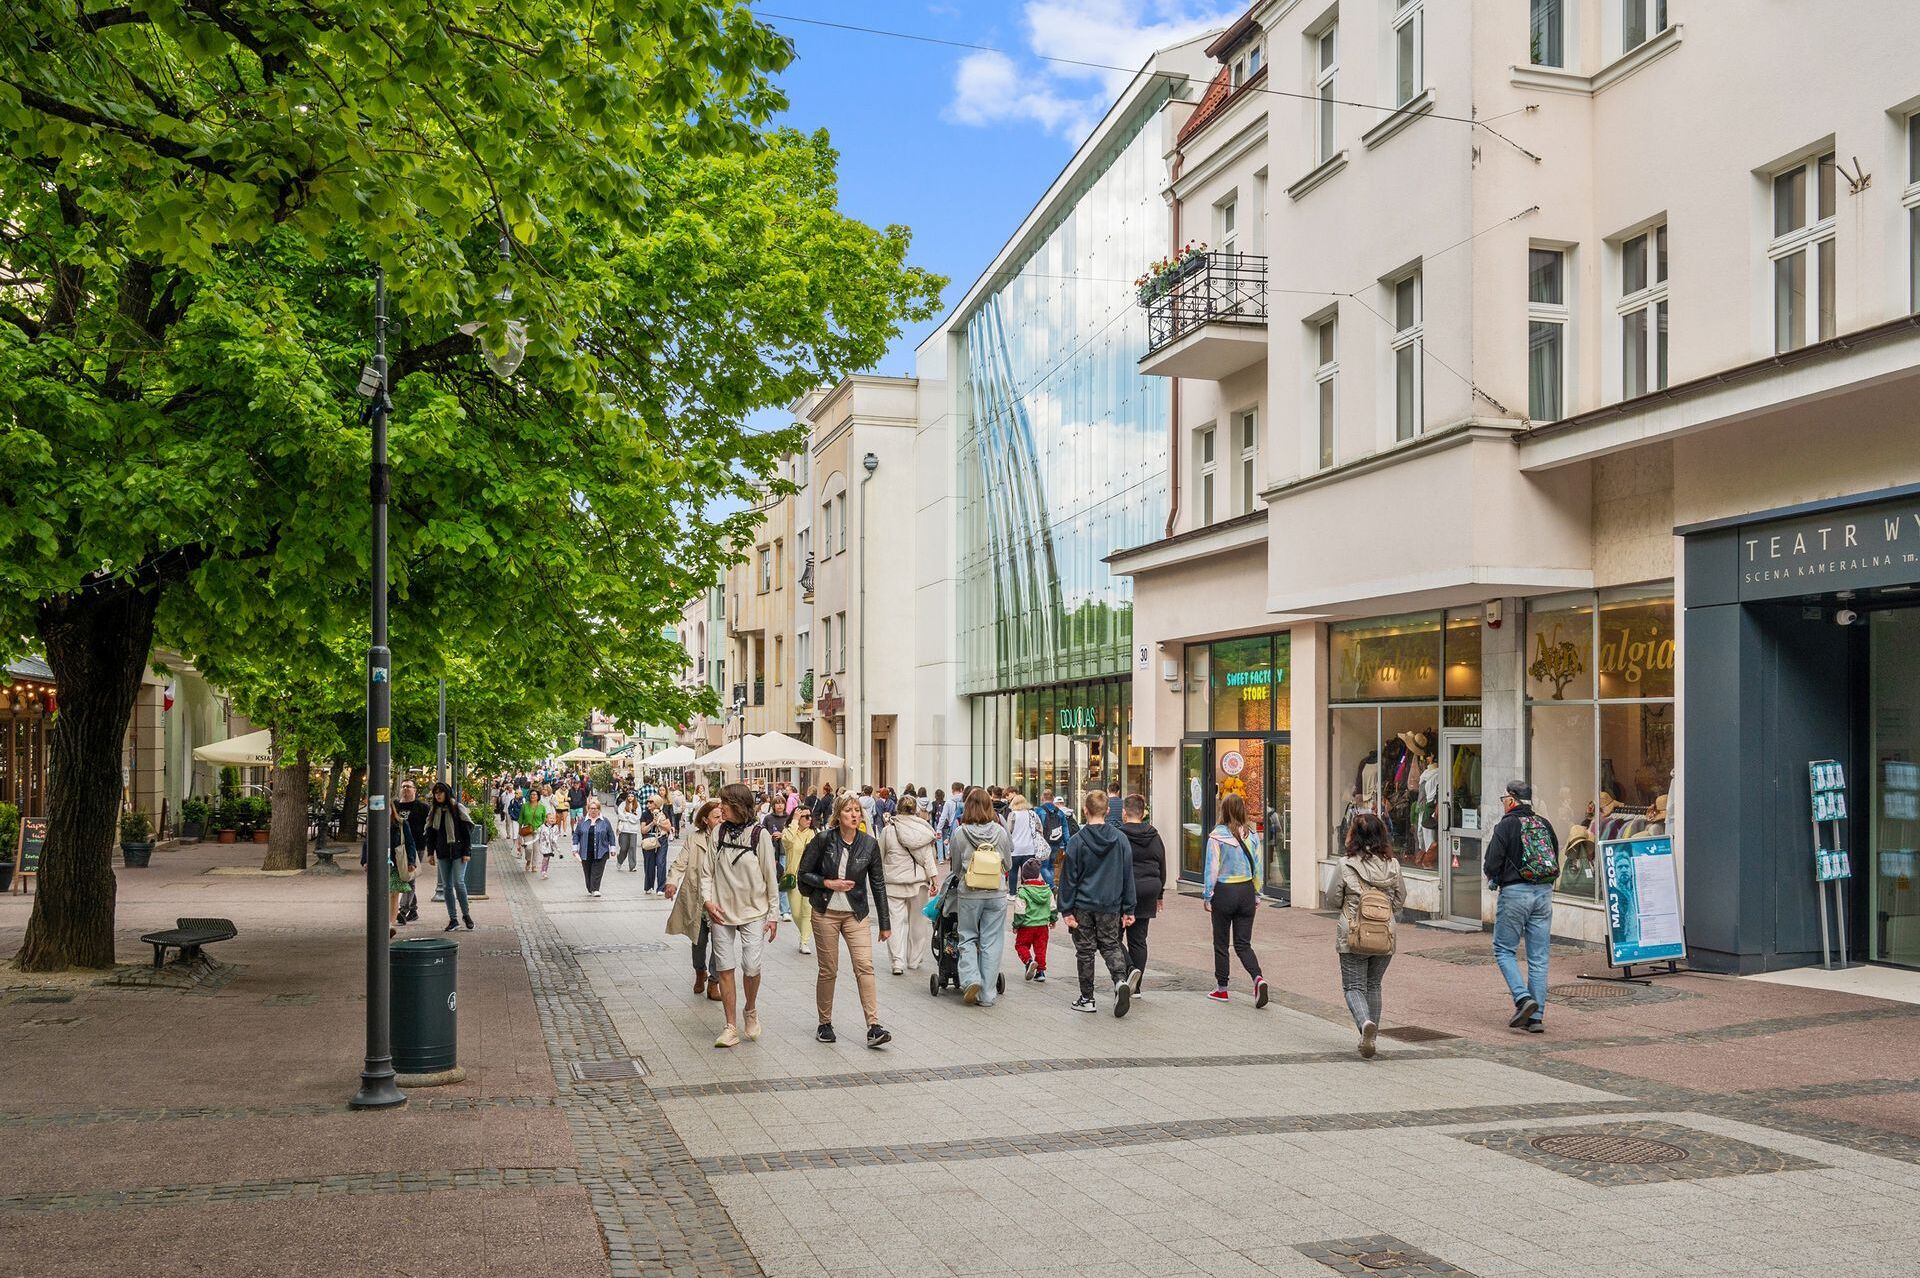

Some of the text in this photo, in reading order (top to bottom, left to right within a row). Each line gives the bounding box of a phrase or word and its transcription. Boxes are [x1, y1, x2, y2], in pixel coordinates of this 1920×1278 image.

[1745, 523, 1859, 562] TEATR
[1745, 568, 1790, 584] SCENA
[1798, 554, 1891, 577] KAMERALNA
[1140, 648, 1148, 662] 30
[1226, 671, 1250, 687] SWEET
[1243, 687, 1267, 701] STORE
[1060, 706, 1096, 729] DOUGLAS
[1605, 845, 1621, 928] MAJ 2025
